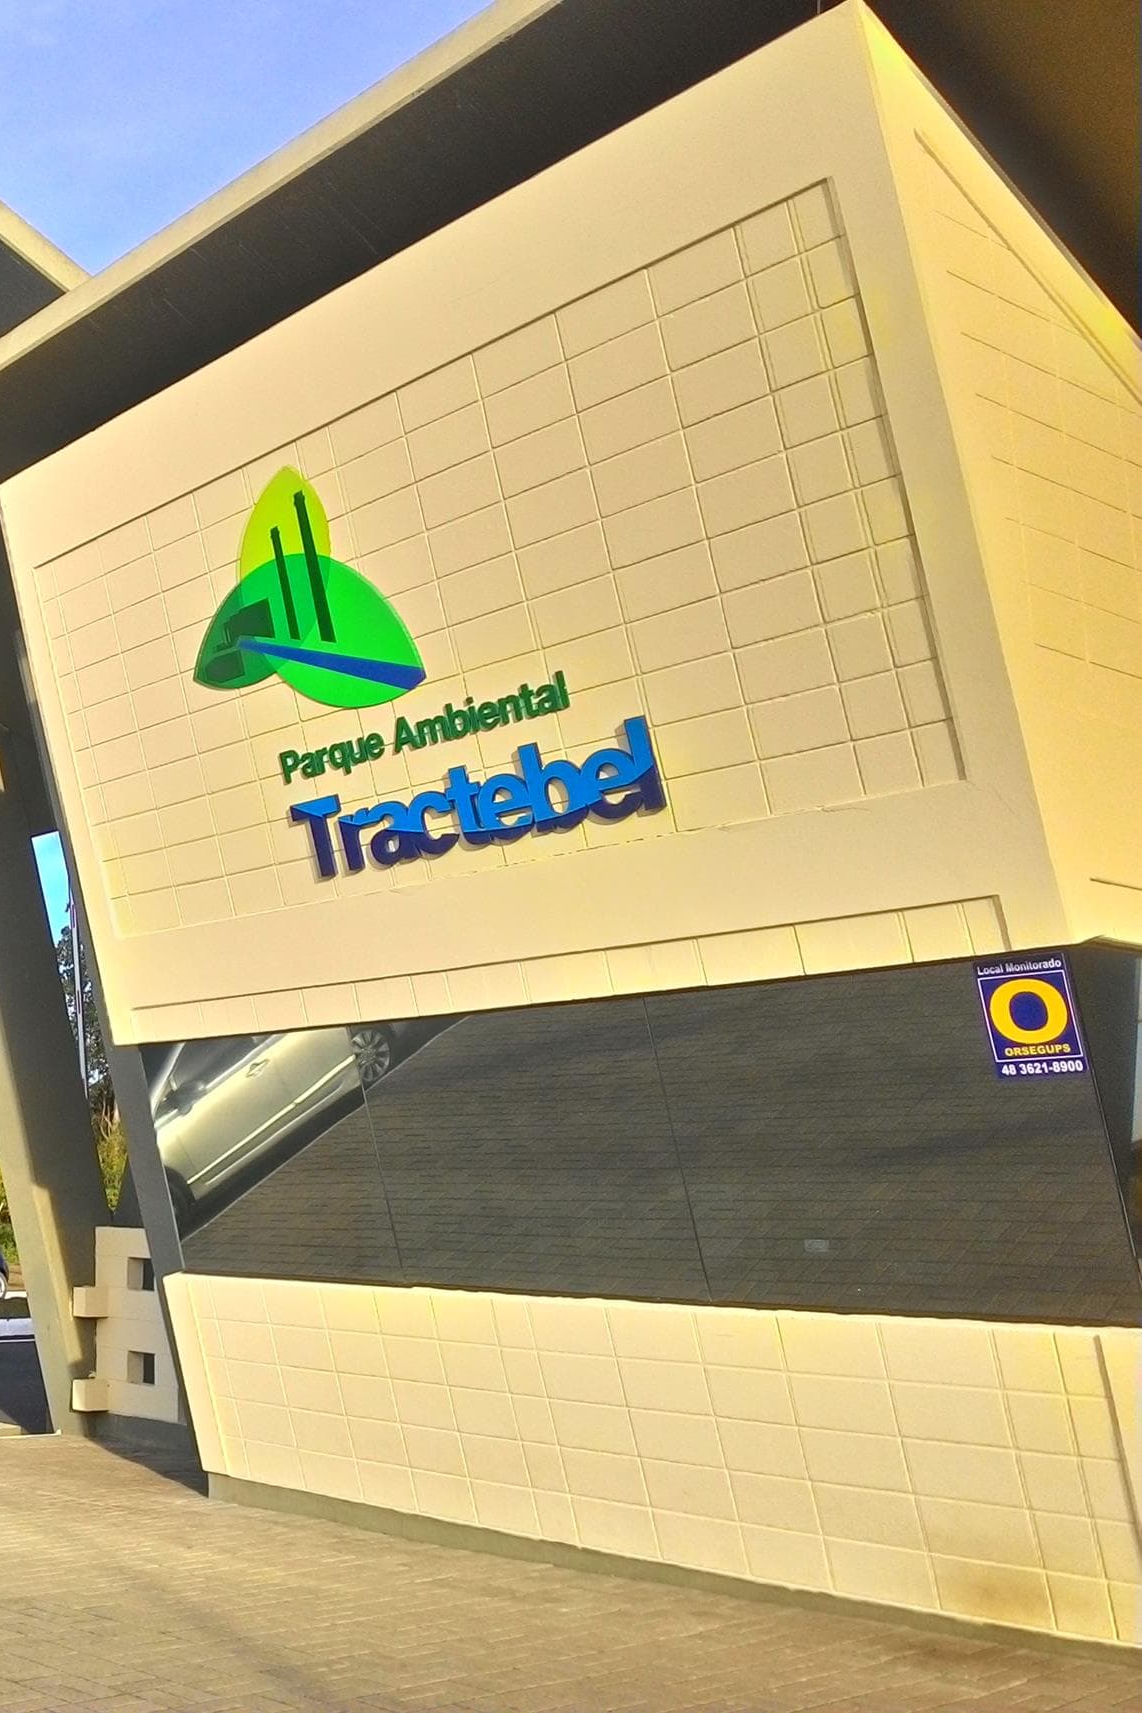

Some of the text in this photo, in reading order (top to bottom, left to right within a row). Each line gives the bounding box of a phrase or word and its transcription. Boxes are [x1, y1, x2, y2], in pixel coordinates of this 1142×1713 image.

[278, 670, 570, 784] Parque Ambiental
[289, 715, 667, 878] Tractebel
[977, 958, 1062, 976] Local Monitorado
[1004, 1043, 1071, 1056] ORSEGUPS
[1001, 1060, 1084, 1076] 48 3621-8900
